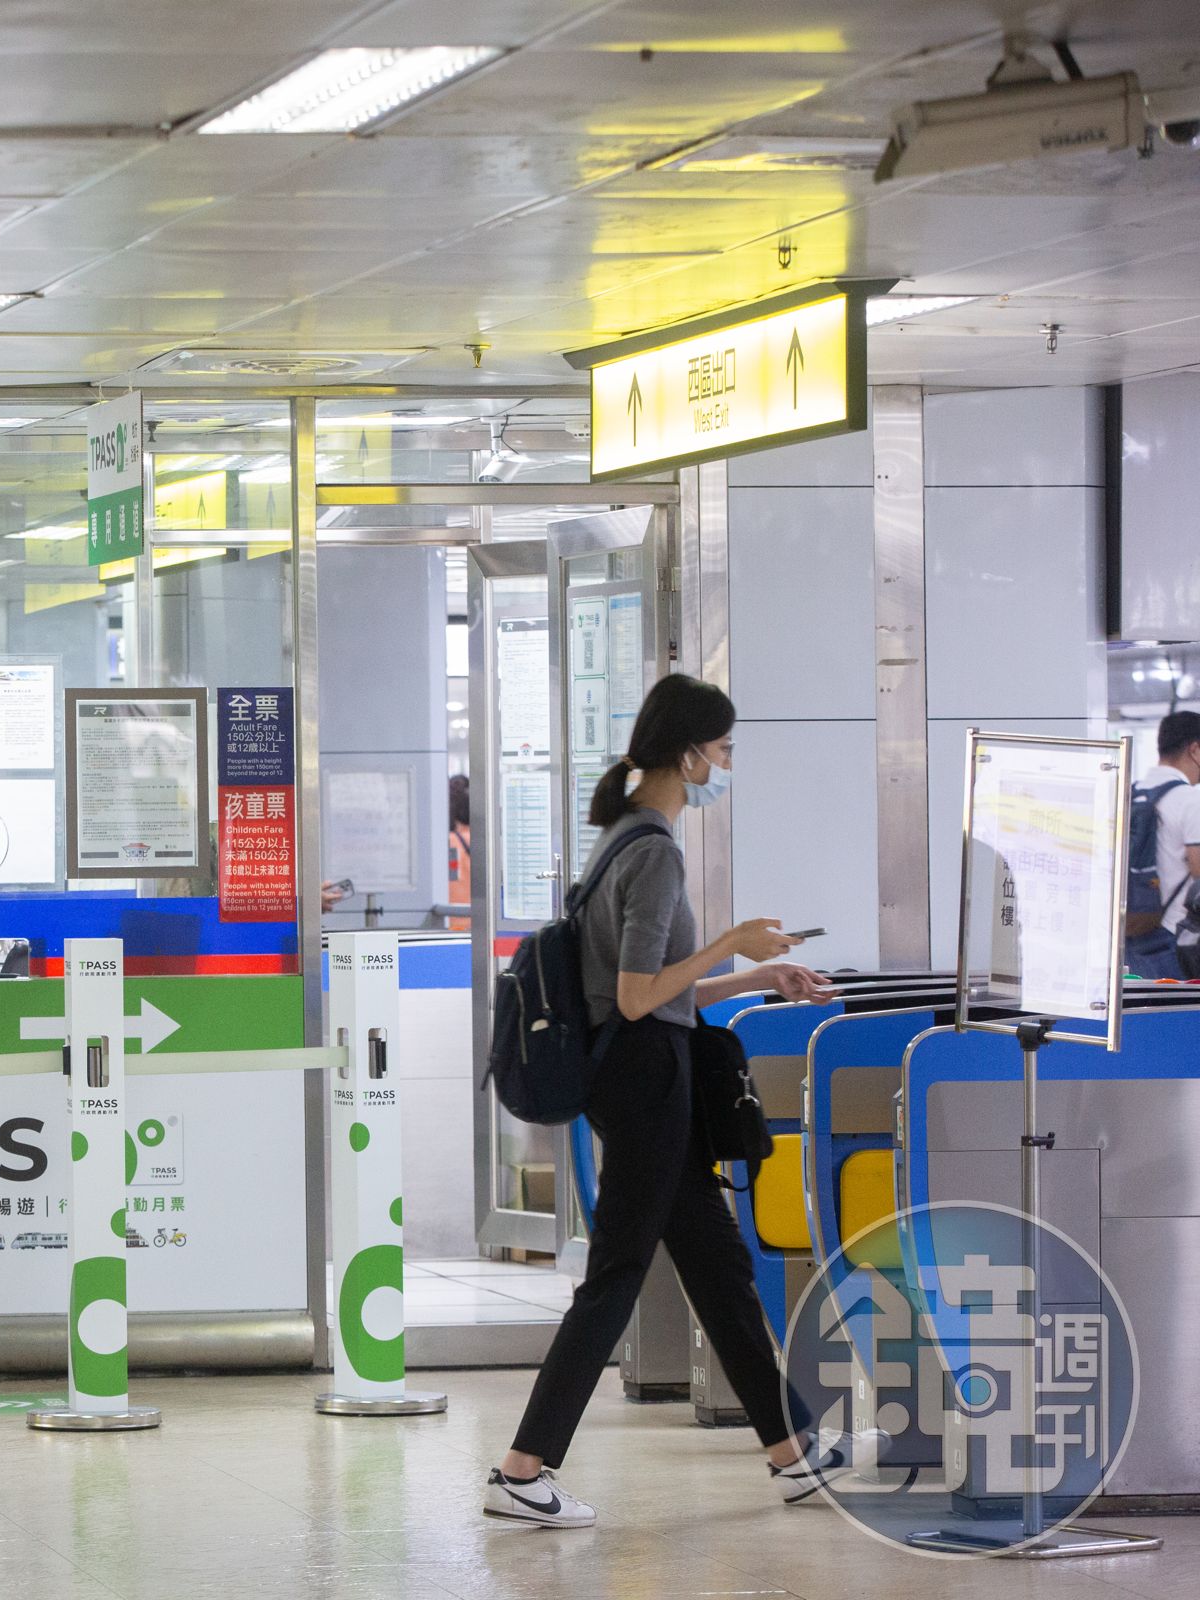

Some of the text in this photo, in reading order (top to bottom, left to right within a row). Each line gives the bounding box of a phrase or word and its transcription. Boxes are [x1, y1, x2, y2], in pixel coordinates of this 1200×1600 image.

[688, 348, 736, 402] 西區出口
[694, 403, 730, 434] West Exit
[89, 430, 116, 473] TPASS
[228, 694, 279, 721] 全票
[230, 723, 278, 731] Adult Fare
[227, 731, 286, 742] 150公分以上
[224, 792, 286, 820] 孩童票
[226, 825, 283, 834] Children Fare
[226, 837, 290, 849] 115公分以上
[225, 850, 290, 861] 未滿150公分
[224, 882, 247, 890] People
[270, 882, 292, 890] height
[360, 954, 394, 964] TPASS
[78, 960, 117, 970] TPASS
[362, 1090, 396, 1100] TPASS
[79, 1099, 118, 1108] TPASS
